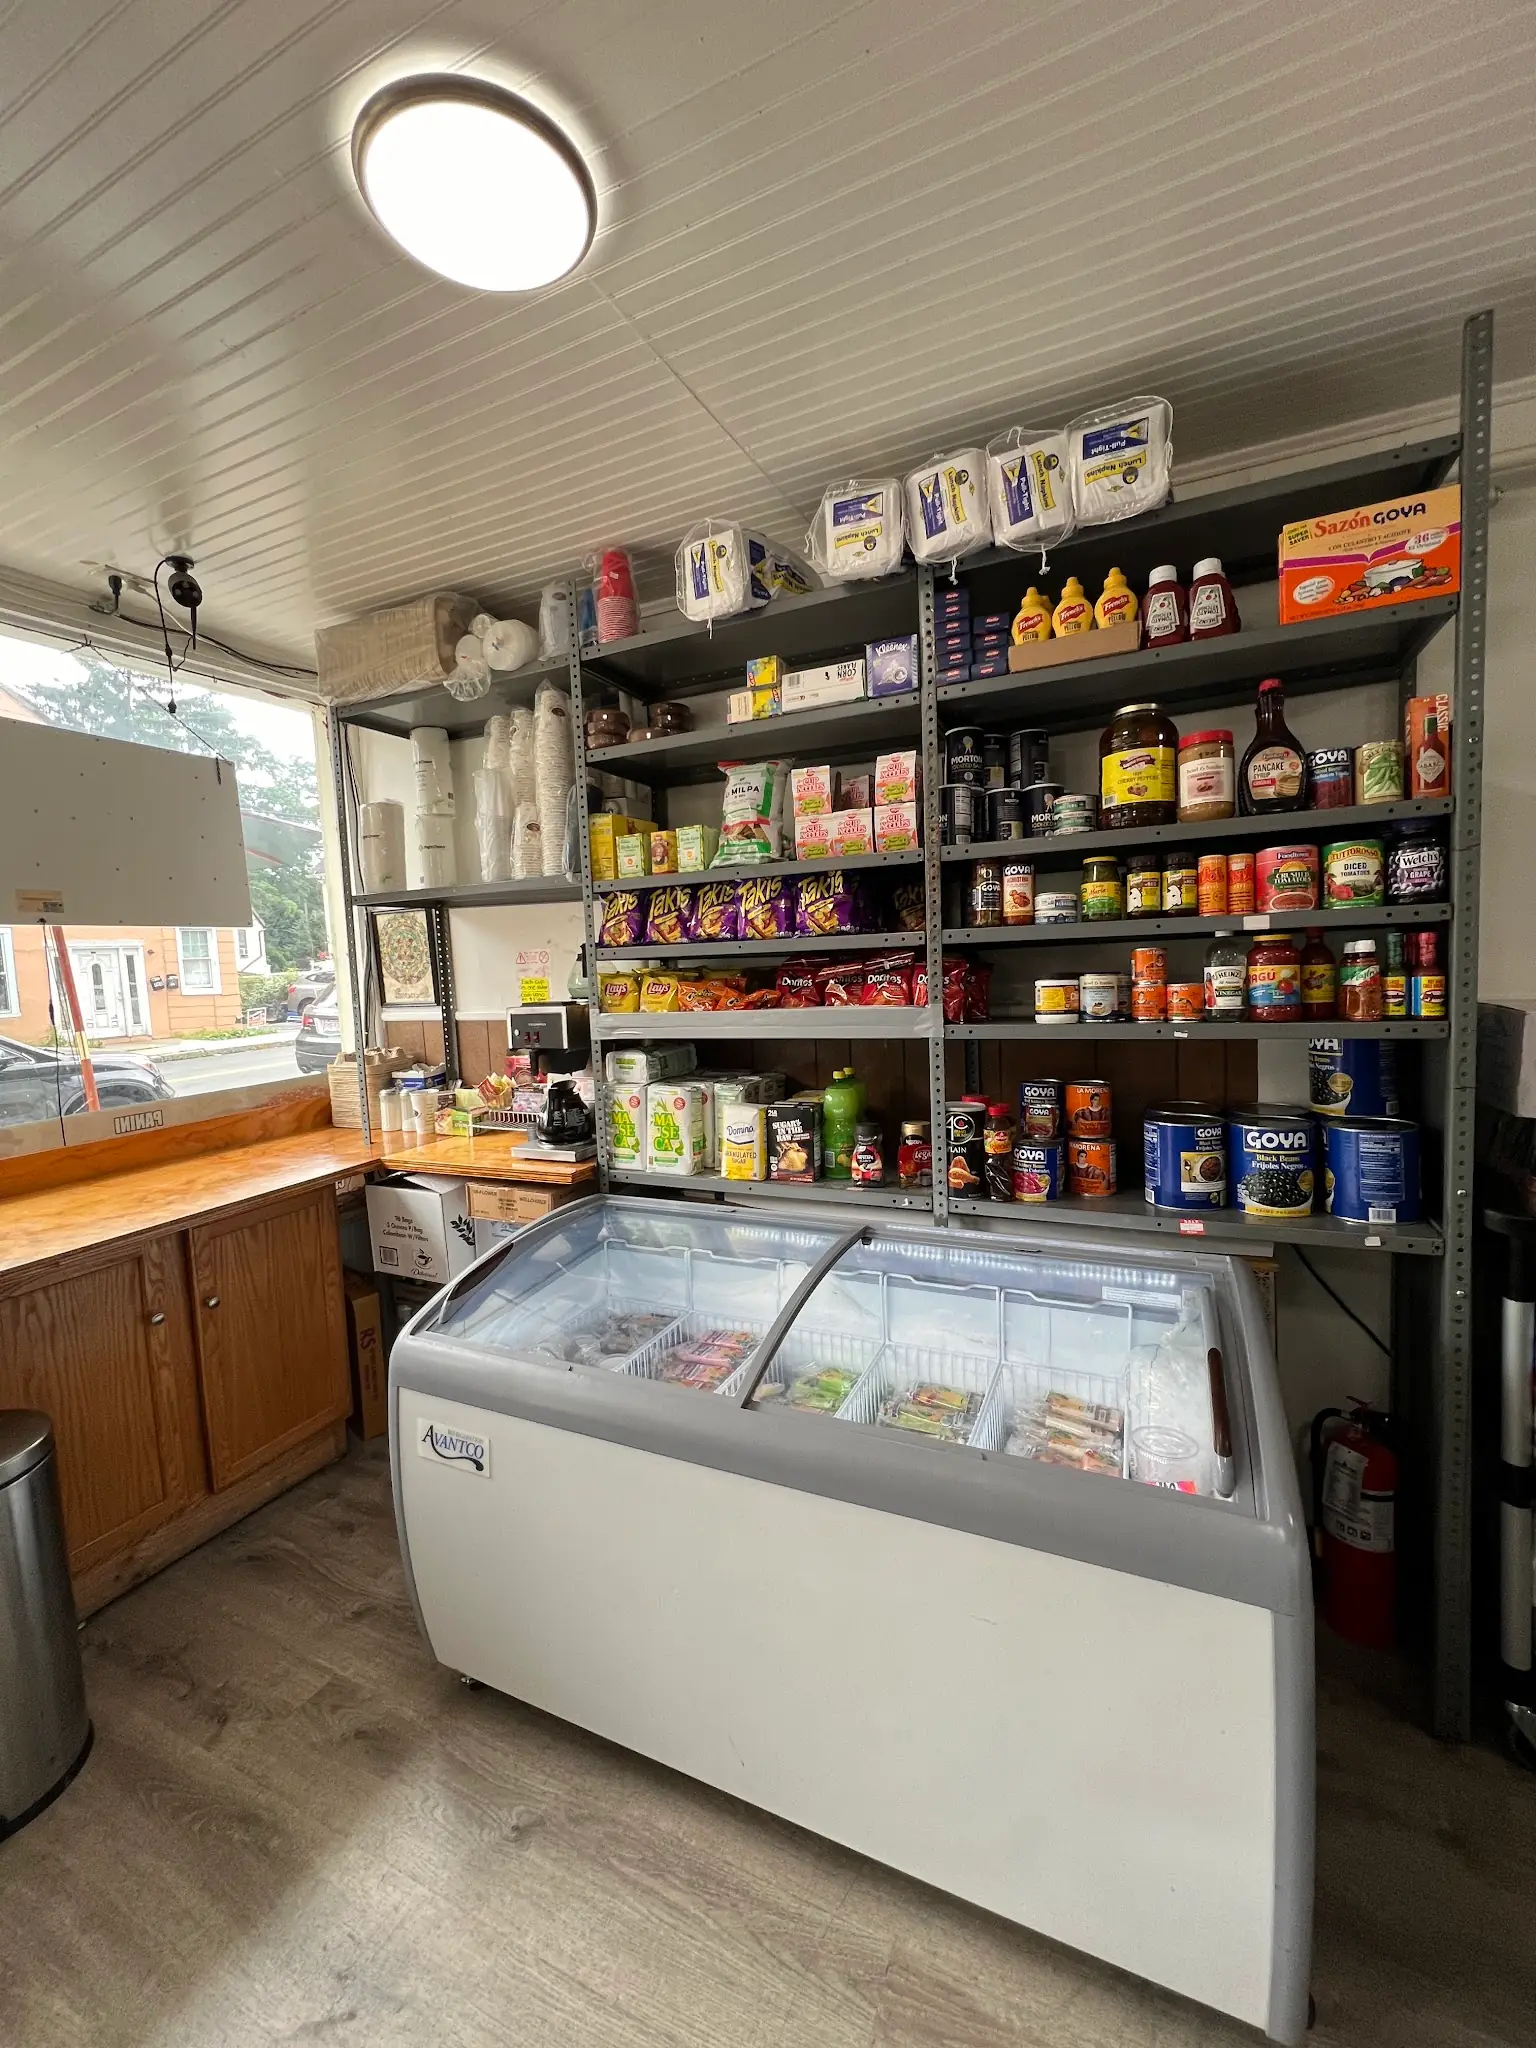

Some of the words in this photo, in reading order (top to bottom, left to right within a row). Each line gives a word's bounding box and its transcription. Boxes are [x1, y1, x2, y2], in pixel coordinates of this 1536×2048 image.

[1090, 439, 1127, 456] Pull-Tight
[1121, 456, 1143, 469] Lunch
[1086, 463, 1117, 479] Napkins
[947, 471, 956, 495] Lunch
[1035, 454, 1044, 476] Lunch
[1040, 478, 1050, 508] Napkins
[1018, 477, 1031, 511] Pull-Tight
[950, 496, 960, 522] Napkins
[1314, 511, 1371, 538] Sazón
[1373, 503, 1427, 525] GOYA
[1288, 529, 1309, 541] SUPER
[1289, 535, 1310, 546] SAVER
[1414, 533, 1430, 545] 36
[1104, 596, 1128, 612] French's
[1060, 604, 1083, 621] French's
[1019, 615, 1042, 631] French's
[875, 642, 908, 657] Kleenex
[837, 662, 857, 672] FLAKES
[837, 668, 857, 679] CORN
[1436, 693, 1449, 732] CLASSIC
[951, 755, 983, 765] MORTON
[1310, 749, 1348, 766] GOYA
[887, 761, 904, 772] CUP
[1253, 761, 1285, 773] PANCAKE
[880, 767, 910, 779] NOODLES
[803, 777, 819, 786] CUP
[731, 786, 760, 796] MILPA
[796, 783, 825, 793] NOODLES
[844, 819, 861, 828] CUP
[886, 813, 904, 823] CUP
[1031, 813, 1054, 822] MORT
[806, 824, 823, 833] CUP
[837, 824, 867, 835] NOODLES
[880, 819, 911, 830] NOODLES
[799, 830, 828, 840] NOODLES
[1331, 847, 1378, 860] TUTTOROSSO
[1402, 852, 1439, 866] Welch's
[1004, 865, 1031, 876] GOYA
[1344, 862, 1368, 870] DICED
[1274, 876, 1312, 884] TOMATOES
[1275, 871, 1310, 879] CRUSHED
[1410, 870, 1432, 879] GRAPE
[798, 870, 843, 910] Takis
[697, 883, 735, 919] Takis
[737, 875, 782, 918] Takis
[602, 891, 639, 921] Takis
[649, 886, 691, 921] Takis
[867, 974, 902, 985] Doritos
[1218, 971, 1240, 979] HEINZ
[781, 976, 813, 987] Doritos
[1024, 1087, 1055, 1097] GOYA
[611, 1111, 631, 1125] MA
[1029, 1108, 1050, 1116] GOYA
[654, 1112, 677, 1126] MA
[772, 1120, 797, 1129] SUGAR
[619, 1124, 635, 1137] SE
[661, 1126, 680, 1140] SE
[726, 1125, 754, 1136] Domino
[786, 1126, 803, 1134] THE
[1197, 1127, 1222, 1138] GOYA
[613, 1134, 630, 1148] CA
[653, 1136, 673, 1151] CA
[776, 1134, 792, 1142] RAW
[1246, 1132, 1307, 1149] GOYA
[1014, 1148, 1045, 1161] GOYA
[1256, 1154, 1278, 1162] Black
[1279, 1155, 1301, 1163] Beans
[1252, 1160, 1280, 1170] Frijoles
[1280, 1163, 1304, 1171] Negros
[421, 1425, 484, 1460] AVANTCO
